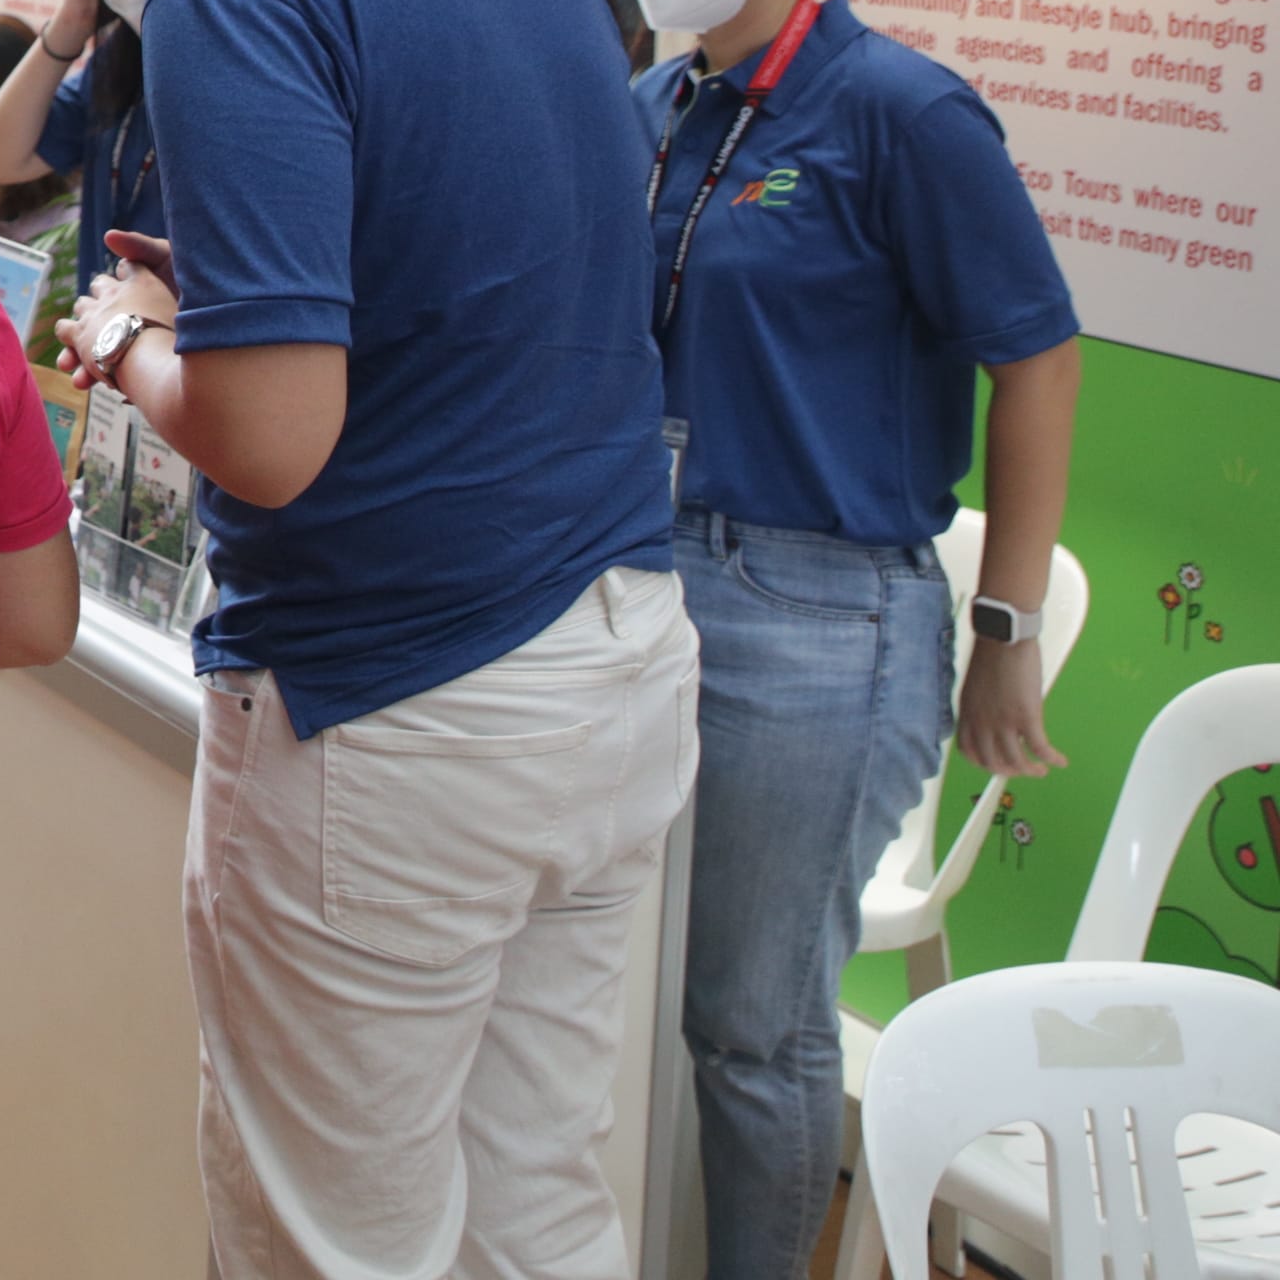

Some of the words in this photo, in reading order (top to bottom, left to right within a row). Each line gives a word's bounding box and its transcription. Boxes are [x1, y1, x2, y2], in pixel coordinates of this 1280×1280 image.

[1109, 9, 1160, 39] hub,
[1168, 12, 1268, 55] bringing
[954, 35, 1046, 65] agencies
[1067, 47, 1108, 73] and
[1132, 54, 1223, 94] offering
[1247, 70, 1263, 92] a
[986, 80, 1071, 112] services
[1077, 90, 1117, 118] and
[1124, 93, 1230, 134] facilities.
[1016, 162, 1052, 191] Eco
[1063, 170, 1122, 204] Tours
[1132, 186, 1203, 218] where
[1215, 201, 1258, 228] our
[1077, 218, 1113, 246] the
[1118, 227, 1181, 263] many
[1184, 240, 1254, 272] green
